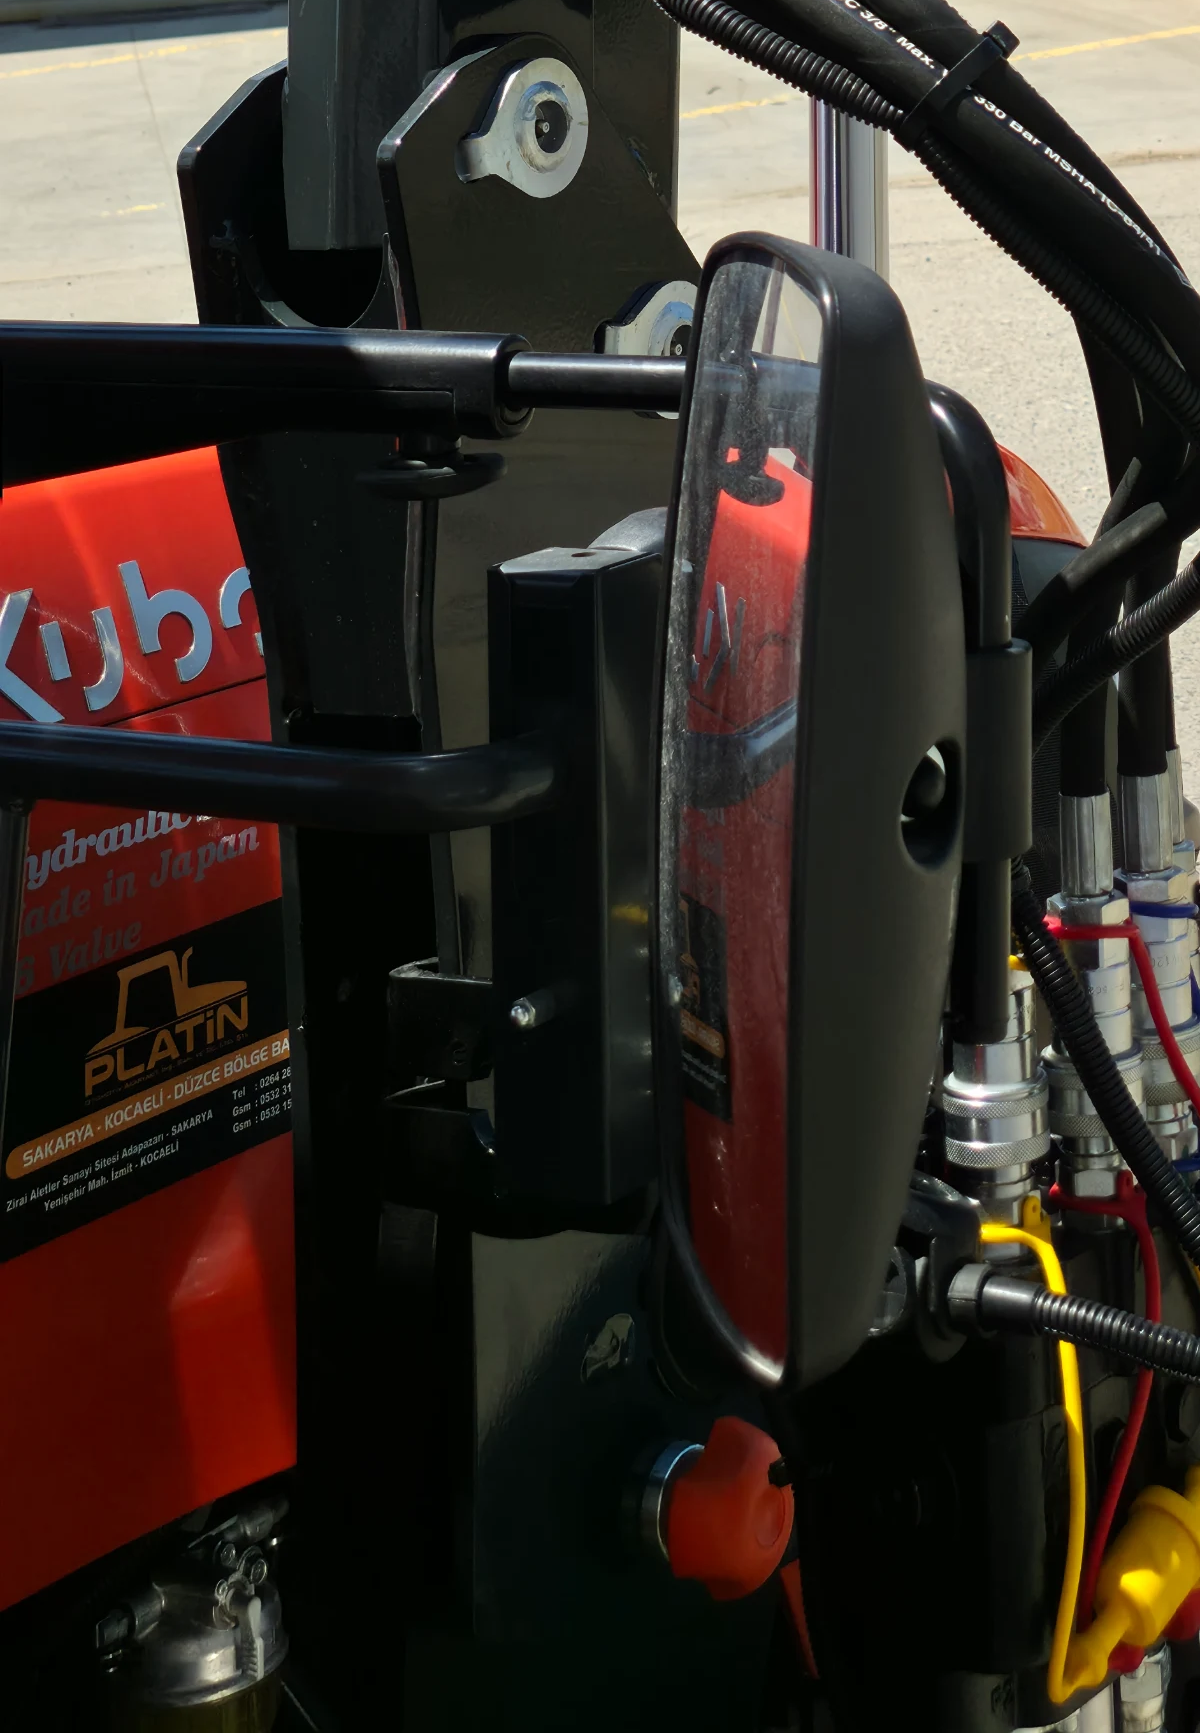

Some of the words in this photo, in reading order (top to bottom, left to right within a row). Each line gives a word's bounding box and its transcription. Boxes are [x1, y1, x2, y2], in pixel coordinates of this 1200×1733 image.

[897, 36, 936, 69] Max.
[973, 93, 1007, 120] 330
[1009, 120, 1041, 146] Bar
[1044, 147, 1097, 195] MSHA
[19, 885, 92, 940] ade
[103, 869, 138, 907] in
[149, 826, 260, 888] Japan
[26, 810, 192, 890] ydraulic
[50, 921, 143, 982] Valve
[22, 1123, 94, 1168] SAKARYA
[104, 1088, 164, 1131] KOCAELİ
[174, 1067, 220, 1100] DÜZCE
[223, 1045, 269, 1079] BÖLGE
[232, 1086, 246, 1100] Tel
[259, 1071, 280, 1089] 0264
[232, 1102, 251, 1117] Gsm
[260, 1087, 280, 1106] 0532
[232, 1118, 252, 1133] Gsm
[260, 1104, 280, 1121] 0532
[6, 1193, 28, 1212] Zirai
[29, 1180, 61, 1201] Aletler
[62, 1163, 93, 1186] Sanayi
[94, 1151, 120, 1172] Sitesi
[171, 1109, 214, 1136] SAKARYA
[44, 1185, 86, 1212] Yenişehir
[88, 1175, 109, 1192] Mah.
[111, 1163, 133, 1181] İzmit
[140, 1138, 179, 1168] KOCAELİ
